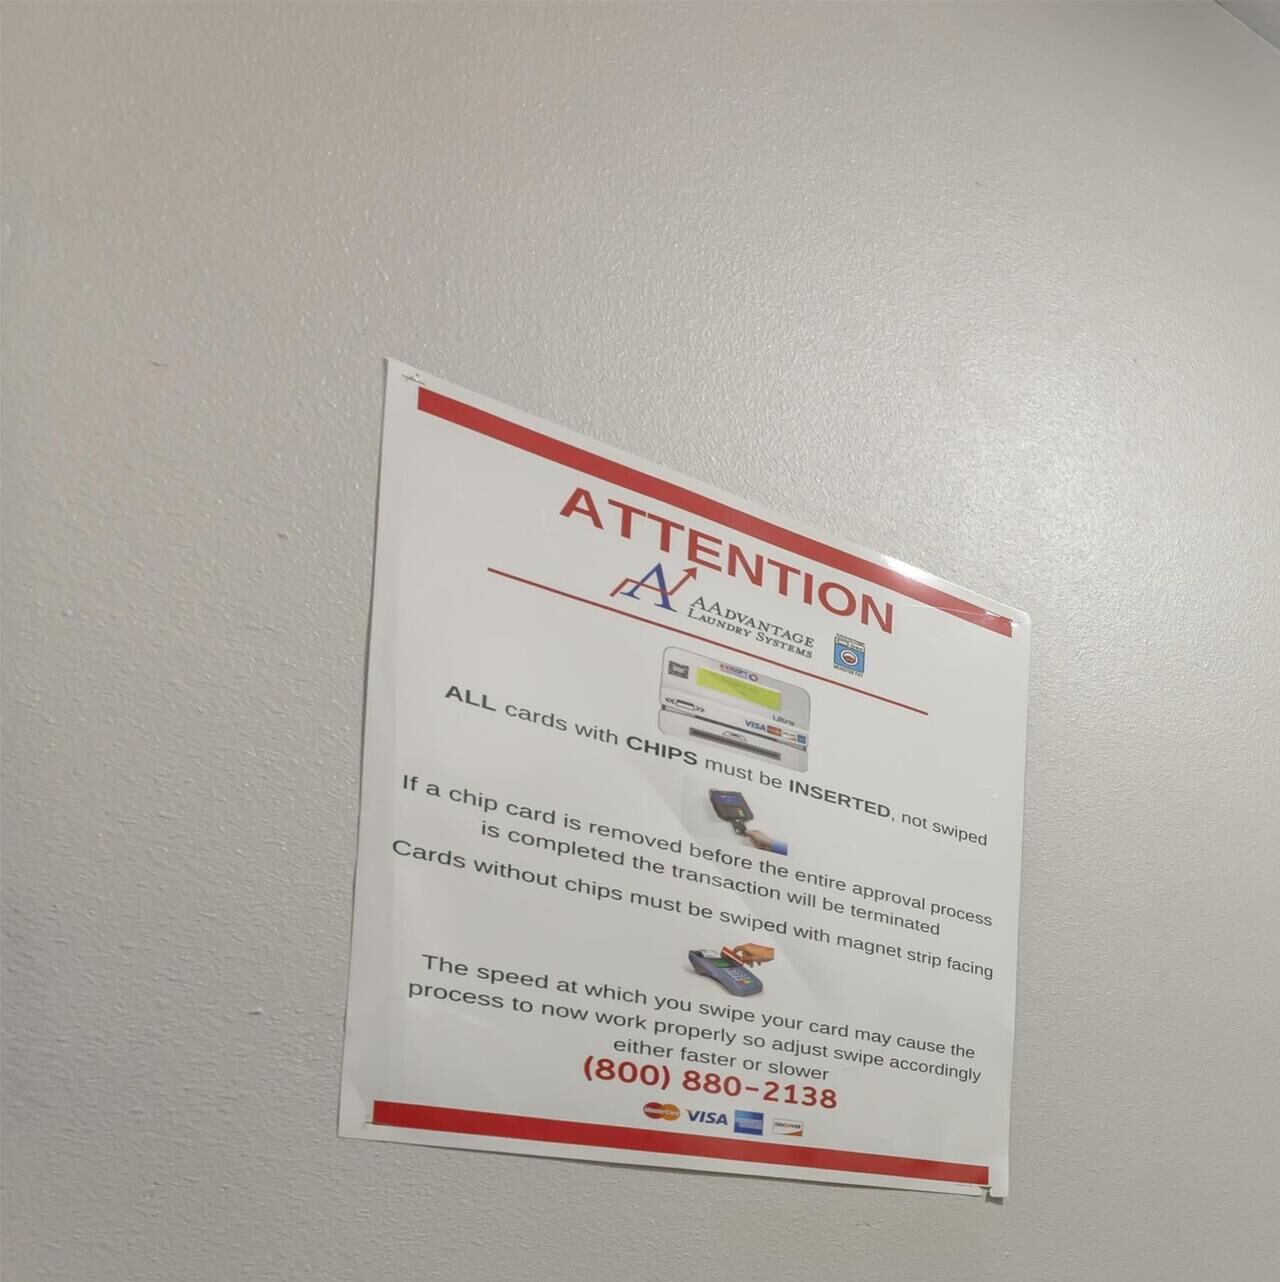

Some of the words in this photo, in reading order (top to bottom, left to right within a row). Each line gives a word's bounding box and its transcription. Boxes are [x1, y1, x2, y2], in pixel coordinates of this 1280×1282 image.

[559, 487, 893, 634] ATTENTION
[687, 607, 751, 637] LAUNDRY
[755, 631, 812, 658] SYSTEMS
[689, 596, 815, 648] AADVANTAGE
[443, 684, 497, 713] ALL
[504, 703, 568, 732] cards
[574, 722, 619, 746] with
[625, 735, 698, 766] CHIPS
[704, 758, 753, 783] must
[758, 769, 783, 790] be
[788, 778, 895, 823] INSERTED,
[900, 812, 928, 830] not
[931, 821, 988, 847] swiped
[402, 773, 419, 792] If
[425, 782, 441, 798] a
[448, 787, 498, 814] chip
[505, 802, 556, 826] card
[563, 812, 582, 831] is
[588, 821, 683, 855] removed
[689, 841, 753, 870] before
[758, 859, 789, 879] the
[794, 869, 847, 892] entire
[851, 883, 926, 911] approval
[929, 902, 993, 927] process
[480, 819, 501, 839] is
[507, 829, 625, 867] completed
[631, 855, 665, 875] the
[670, 863, 781, 901] transaction
[785, 891, 817, 908] will
[821, 895, 845, 914] be
[849, 903, 941, 937] terminated
[391, 839, 467, 869] Cards
[473, 858, 558, 889] without
[564, 877, 623, 901] chips
[629, 891, 682, 914] must
[687, 900, 714, 920] be
[718, 910, 788, 935] swiped
[791, 925, 831, 944] with
[836, 934, 903, 959] magnet
[906, 949, 942, 969] strip
[946, 955, 994, 981] facing
[408, 981, 505, 1009] process
[510, 996, 534, 1014] to
[540, 1002, 589, 1022] now
[594, 1010, 647, 1031] work
[653, 1020, 738, 1047] properly
[741, 1034, 766, 1049] so
[771, 1038, 829, 1058] adjust
[832, 1048, 885, 1068] swipe
[888, 1057, 982, 1085] accordingly
[420, 953, 469, 977] The
[476, 966, 549, 990] speed
[555, 979, 579, 995] at
[583, 983, 647, 1006] which
[653, 994, 692, 1013] you
[698, 1002, 756, 1024] swipe
[760, 1012, 804, 1031] your
[808, 1021, 849, 1038] card
[854, 1028, 892, 1048] may
[895, 1035, 946, 1054] cause
[949, 1042, 976, 1059] the
[582, 1054, 671, 1091] (800)
[681, 1069, 838, 1110] 880-2138
[612, 1037, 674, 1059] either
[679, 1045, 737, 1068] faster
[741, 1058, 763, 1072] or
[767, 1060, 830, 1081] slower
[687, 1109, 728, 1126] VISA
